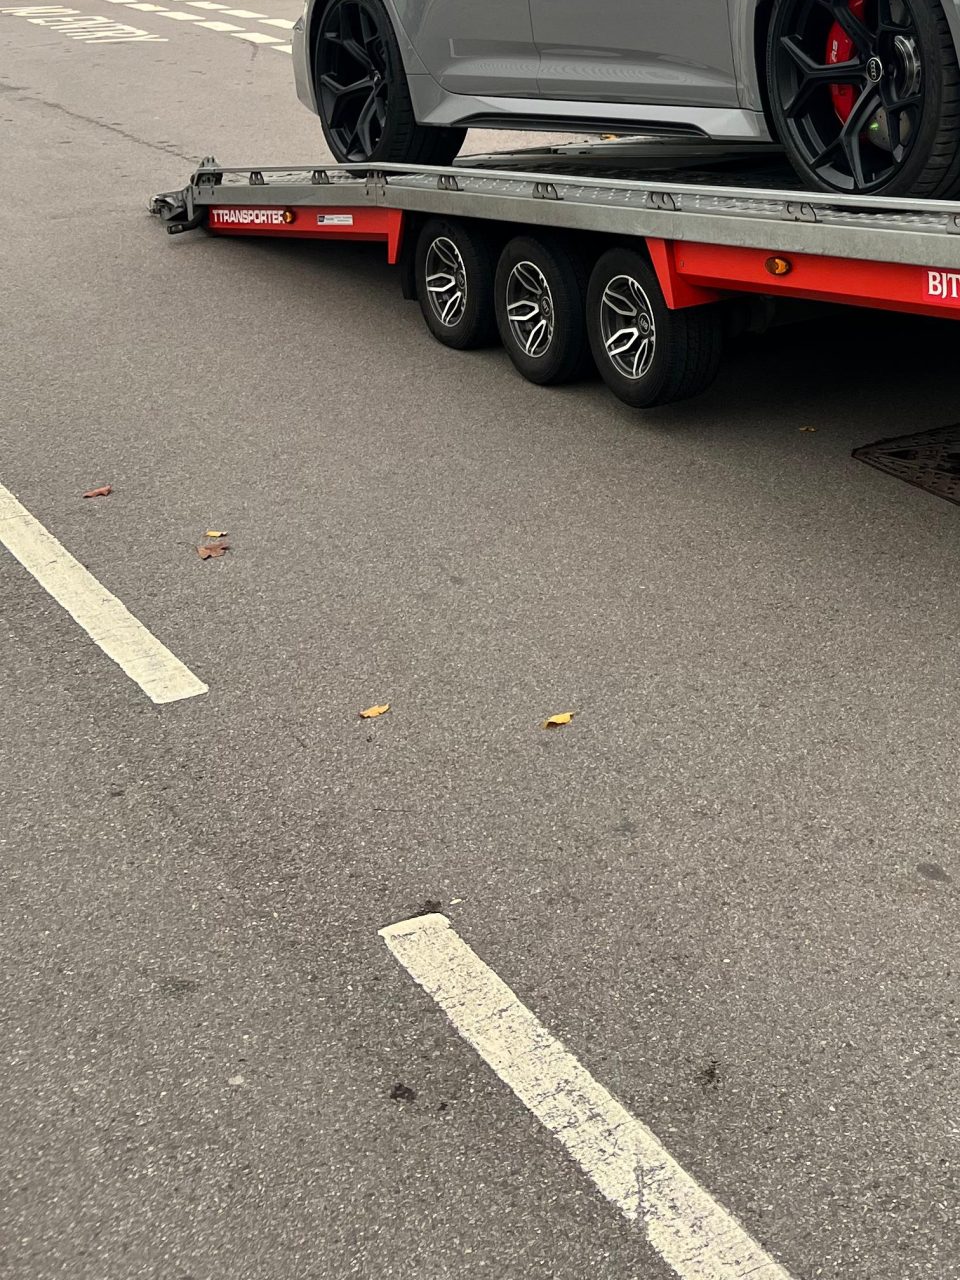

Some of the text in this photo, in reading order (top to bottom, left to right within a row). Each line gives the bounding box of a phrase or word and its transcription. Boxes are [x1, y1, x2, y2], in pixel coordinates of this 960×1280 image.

[0, 5, 81, 17] NO
[26, 15, 170, 43] ENTRY
[927, 271, 960, 299] BJT
